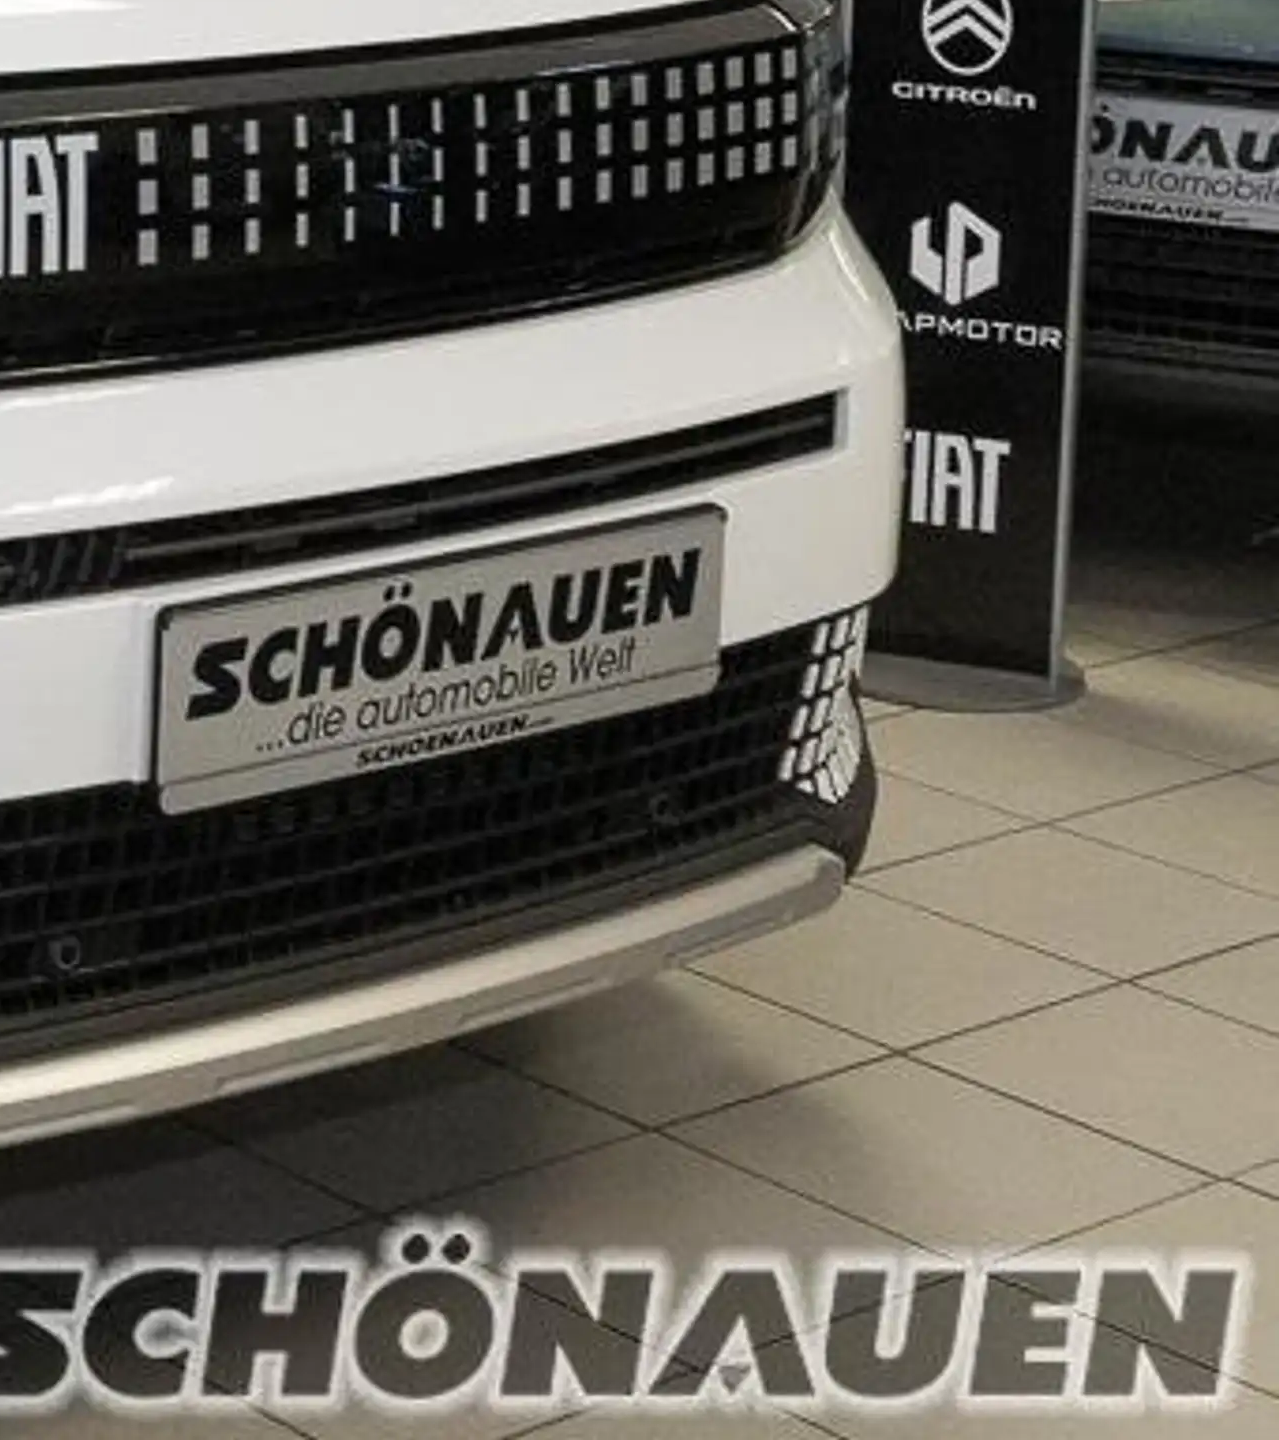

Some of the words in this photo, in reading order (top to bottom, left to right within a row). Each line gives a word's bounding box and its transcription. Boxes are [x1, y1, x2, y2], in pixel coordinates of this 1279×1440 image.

[904, 429, 1011, 534] IAT
[186, 547, 701, 720] SCHÖNAUEN
[356, 658, 557, 729] automobile
[569, 636, 637, 685] Welt
